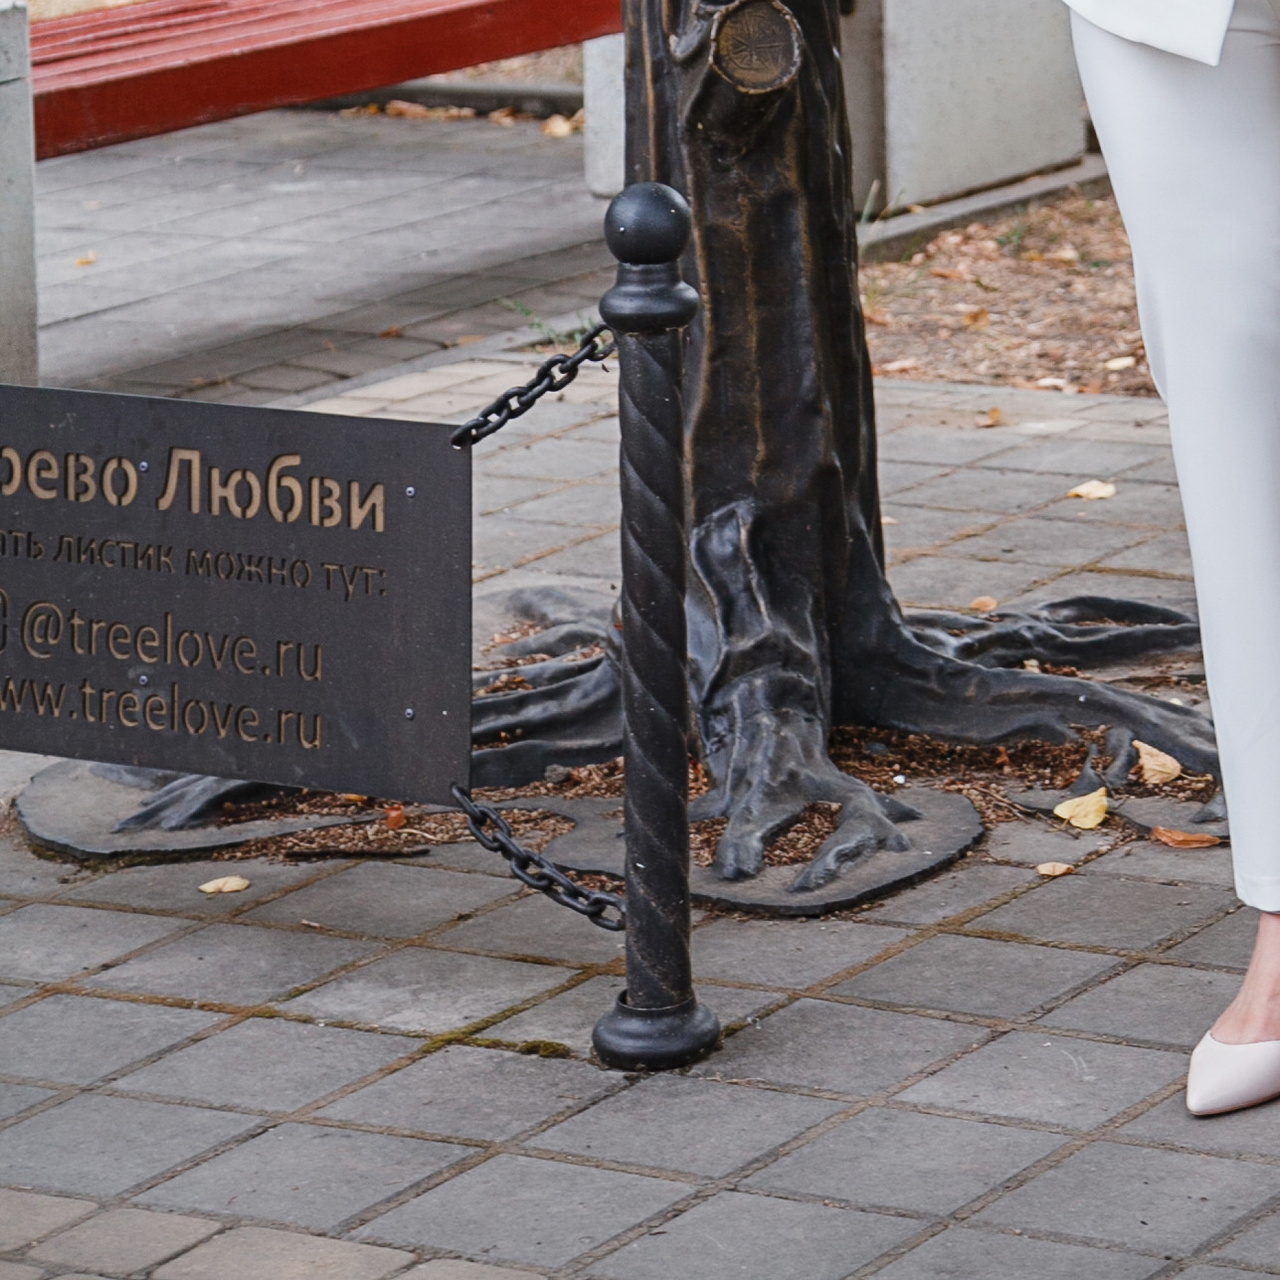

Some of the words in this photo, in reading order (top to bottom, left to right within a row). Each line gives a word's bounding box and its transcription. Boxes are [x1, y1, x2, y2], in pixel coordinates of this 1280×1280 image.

[156, 446, 385, 533] Любви
[53, 535, 175, 574] листик
[186, 548, 313, 589] можно
[320, 562, 387, 602] тут:
[21, 600, 323, 681] @treelove.ru
